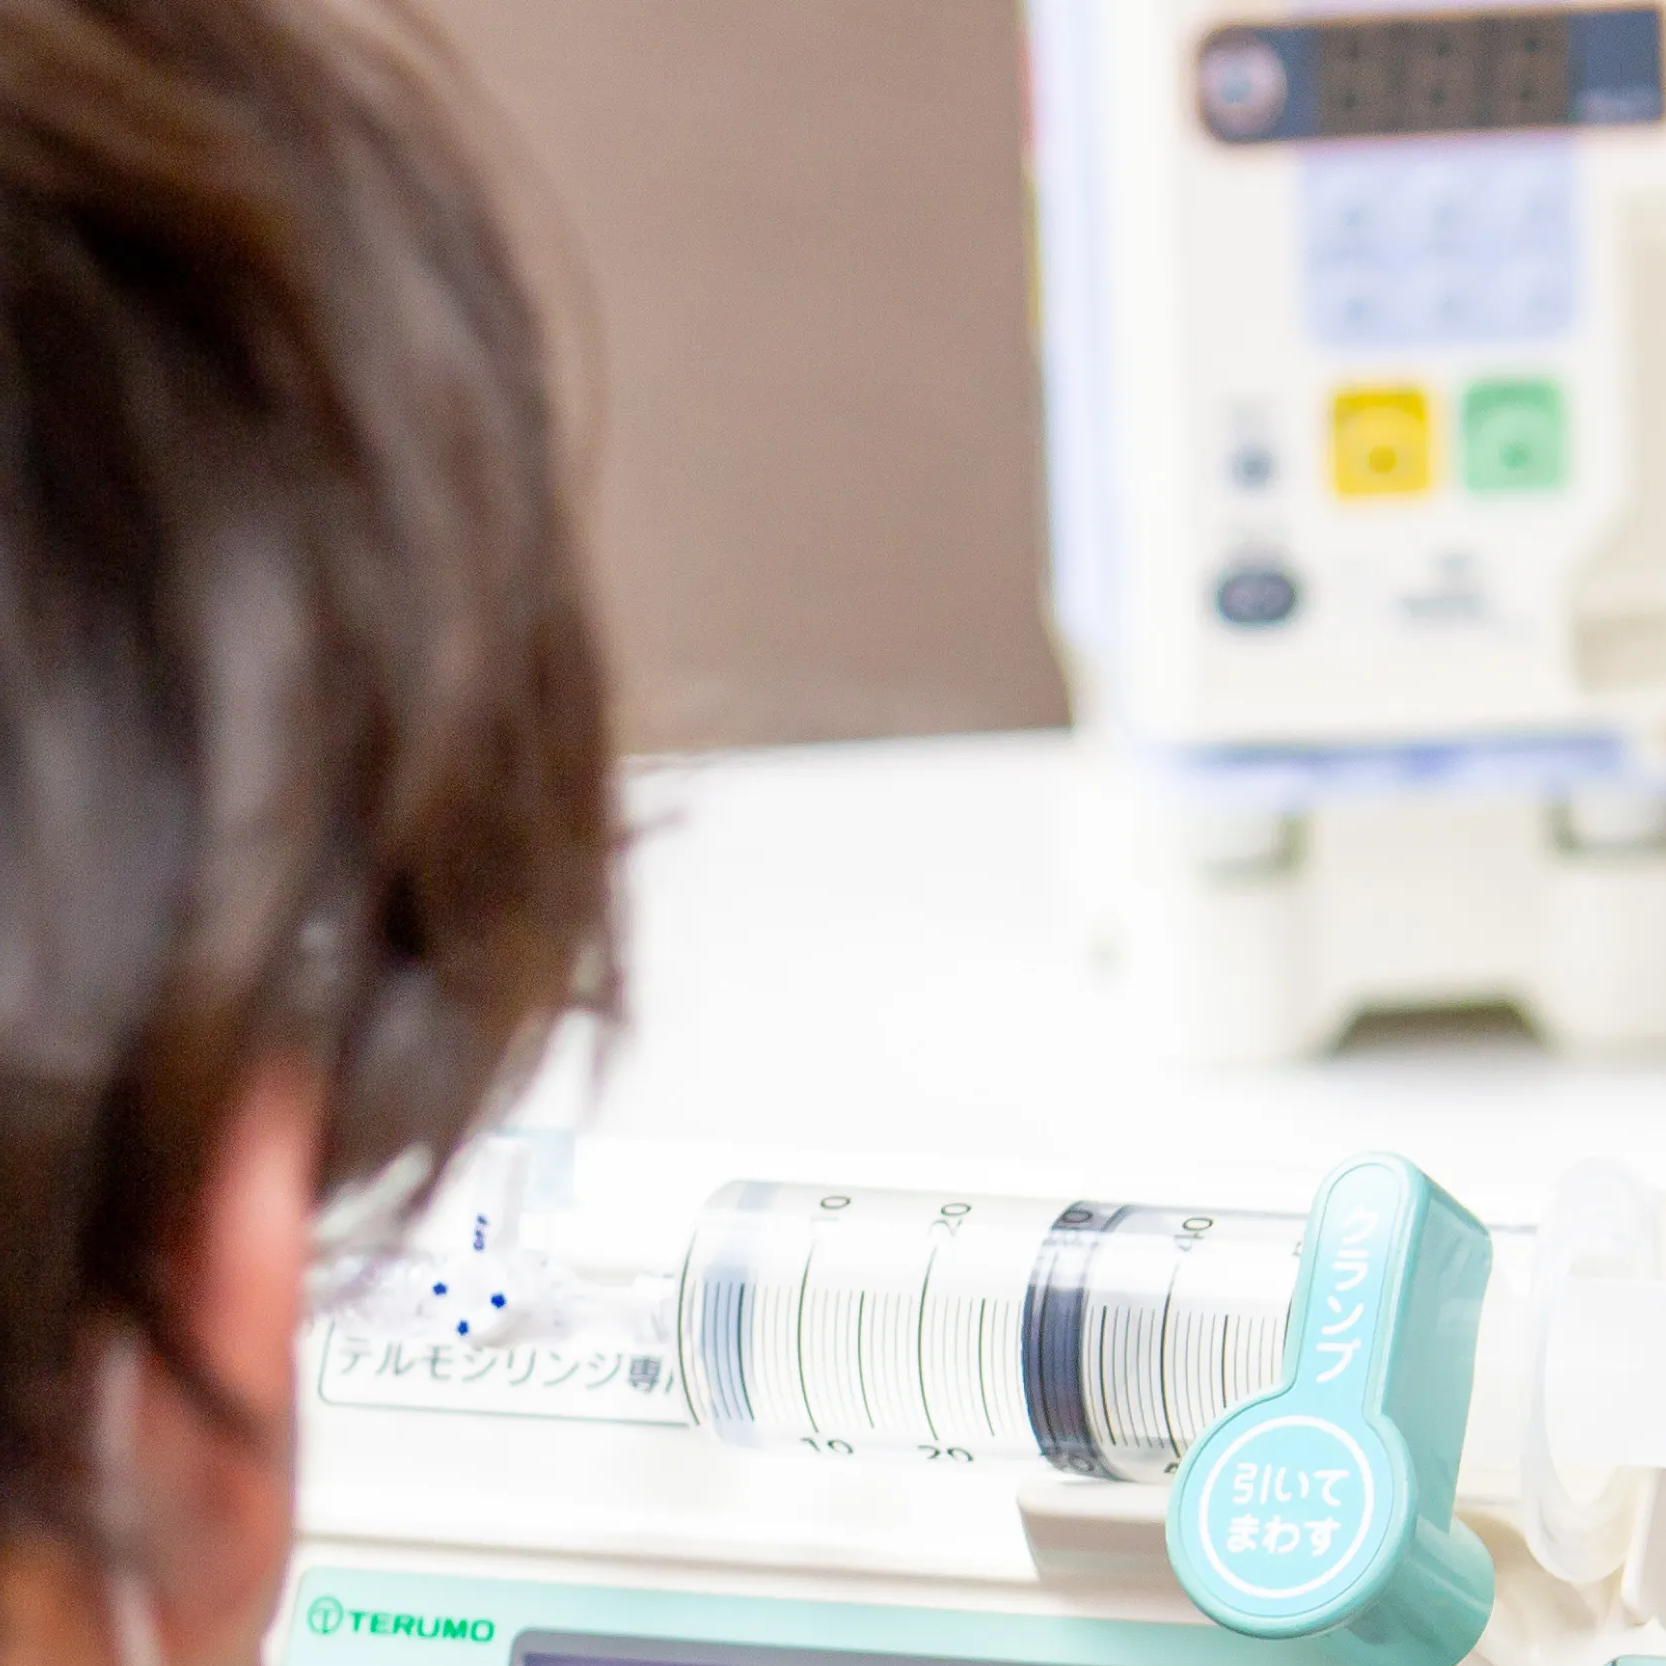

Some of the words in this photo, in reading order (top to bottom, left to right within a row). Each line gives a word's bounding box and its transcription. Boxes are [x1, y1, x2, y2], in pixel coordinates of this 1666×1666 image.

[1315, 1206, 1380, 1384] クランプ
[339, 1336, 676, 1395] テルモシリンジ専
[1231, 1462, 1351, 1509] 引いて
[1226, 1513, 1342, 1557] まわす
[347, 1609, 496, 1644] TERUMO
